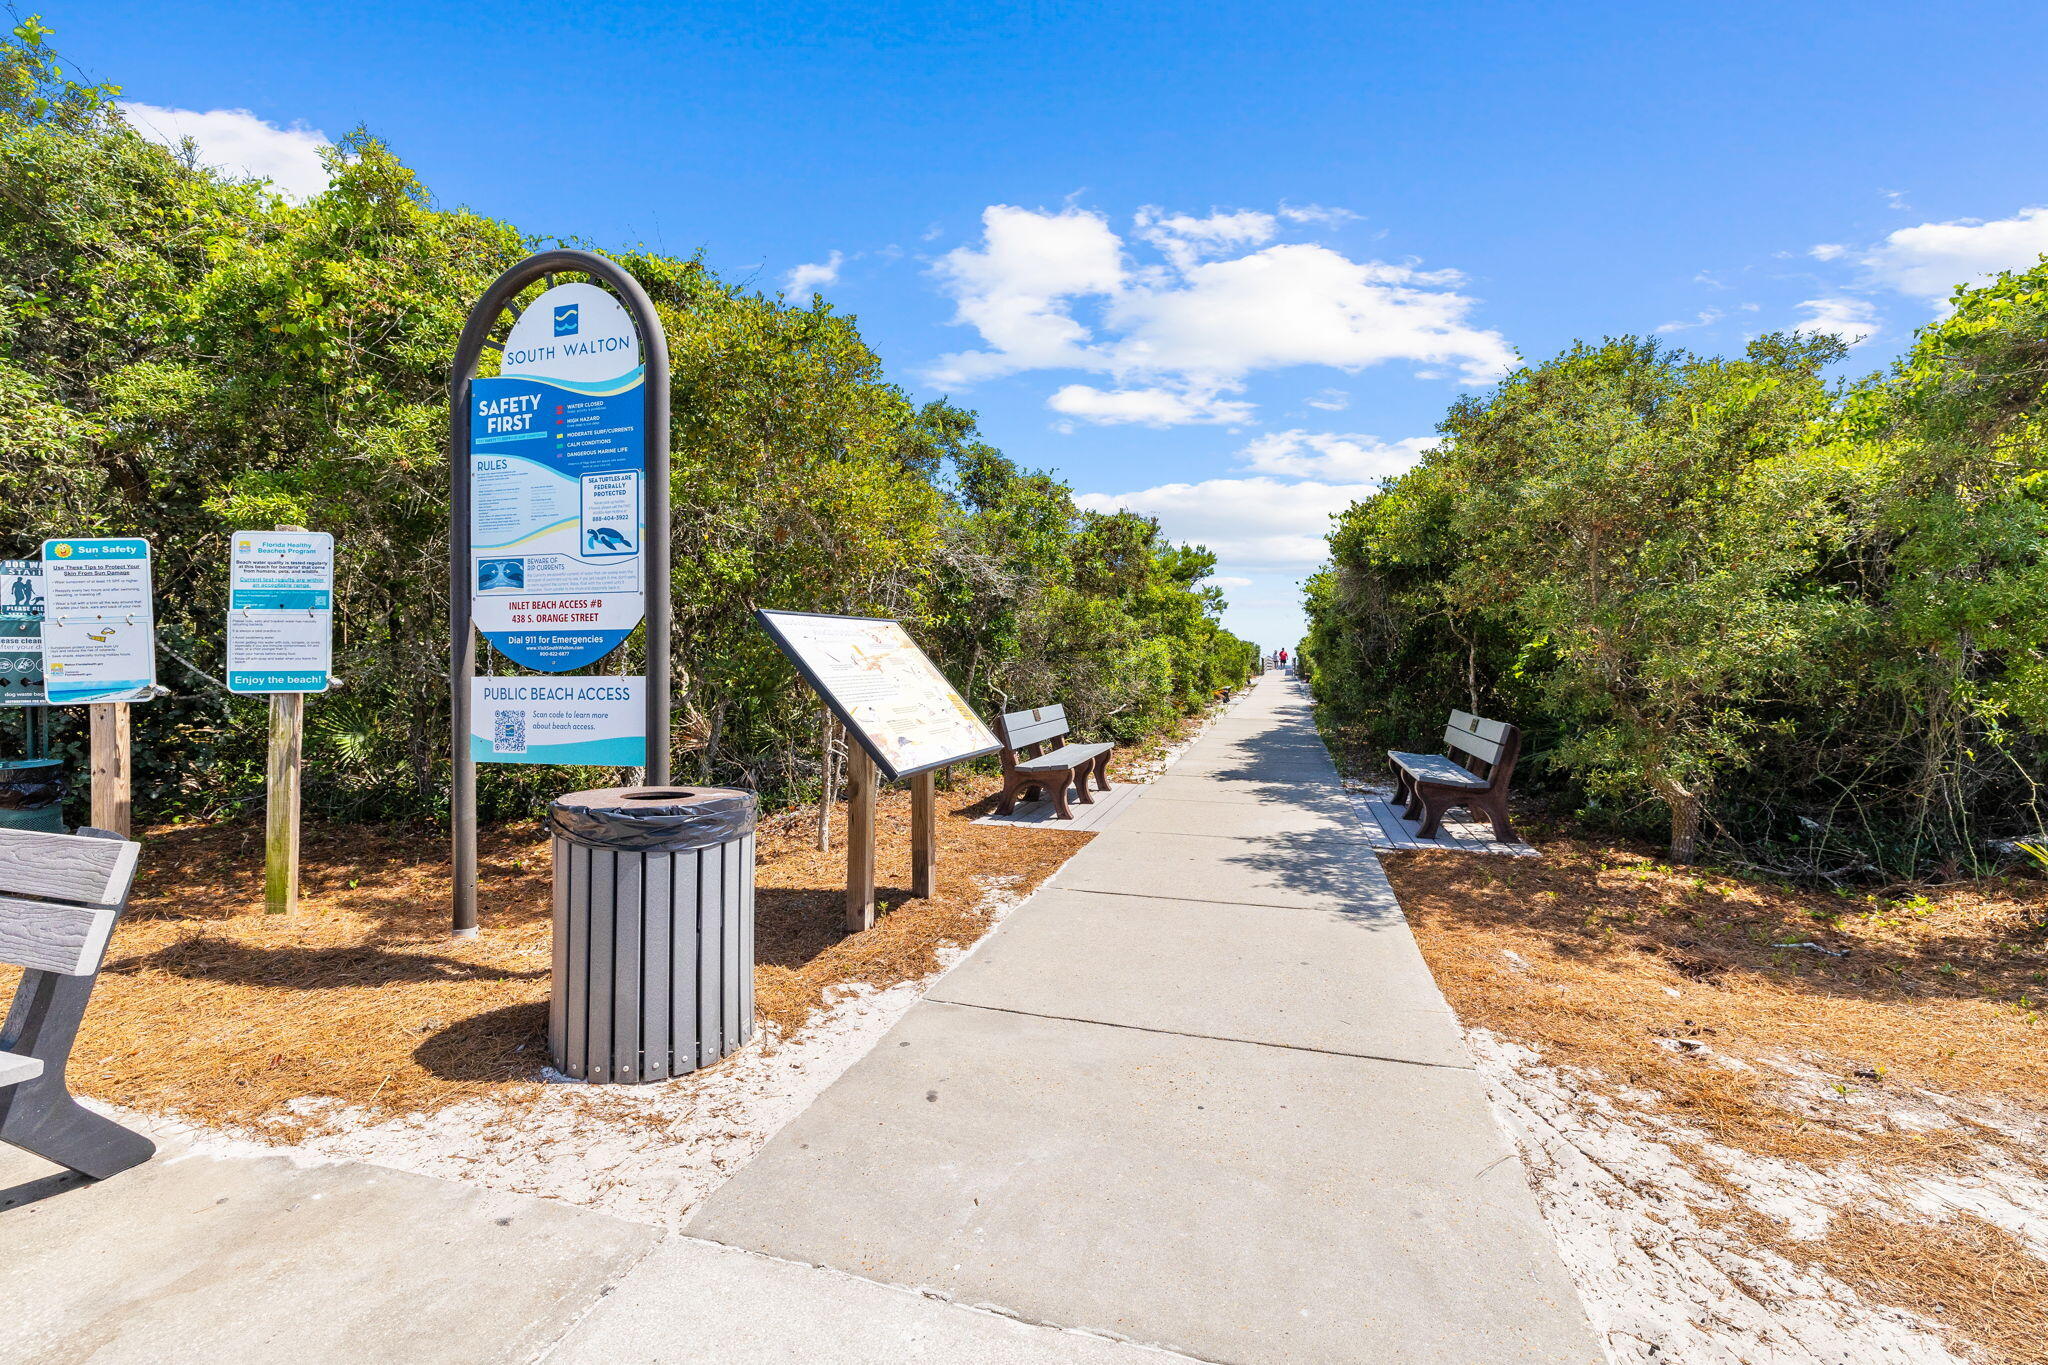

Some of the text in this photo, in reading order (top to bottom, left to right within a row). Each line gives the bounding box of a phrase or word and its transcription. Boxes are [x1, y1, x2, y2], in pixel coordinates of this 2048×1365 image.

[507, 335, 630, 366] SOUTH WALTON
[478, 393, 542, 417] SAFETY
[566, 402, 585, 410] WATER
[487, 413, 533, 434] FIRST
[566, 426, 634, 438] MODERATE SURF/CURRENTS
[581, 438, 612, 446] CONDITIONS
[477, 459, 508, 472] RULES
[599, 475, 620, 483] TURTLES
[593, 482, 626, 490] FEDERALLY
[78, 545, 137, 555] Sun Safety
[508, 601, 529, 610] INLET
[532, 600, 556, 609] BEACH
[558, 599, 588, 609] ACCESS
[512, 612, 599, 623] 438 S. ORANGE STREET
[508, 635, 604, 645] Dial 911 for Emergencies
[234, 675, 322, 686] Enjoy the beach!
[484, 687, 630, 701] PUBLIC BEACH ACCESS
[532, 710, 548, 718] Scan
[549, 710, 565, 718] code
[573, 710, 590, 718] learn
[532, 722, 551, 730] about
[551, 722, 572, 730] beach
